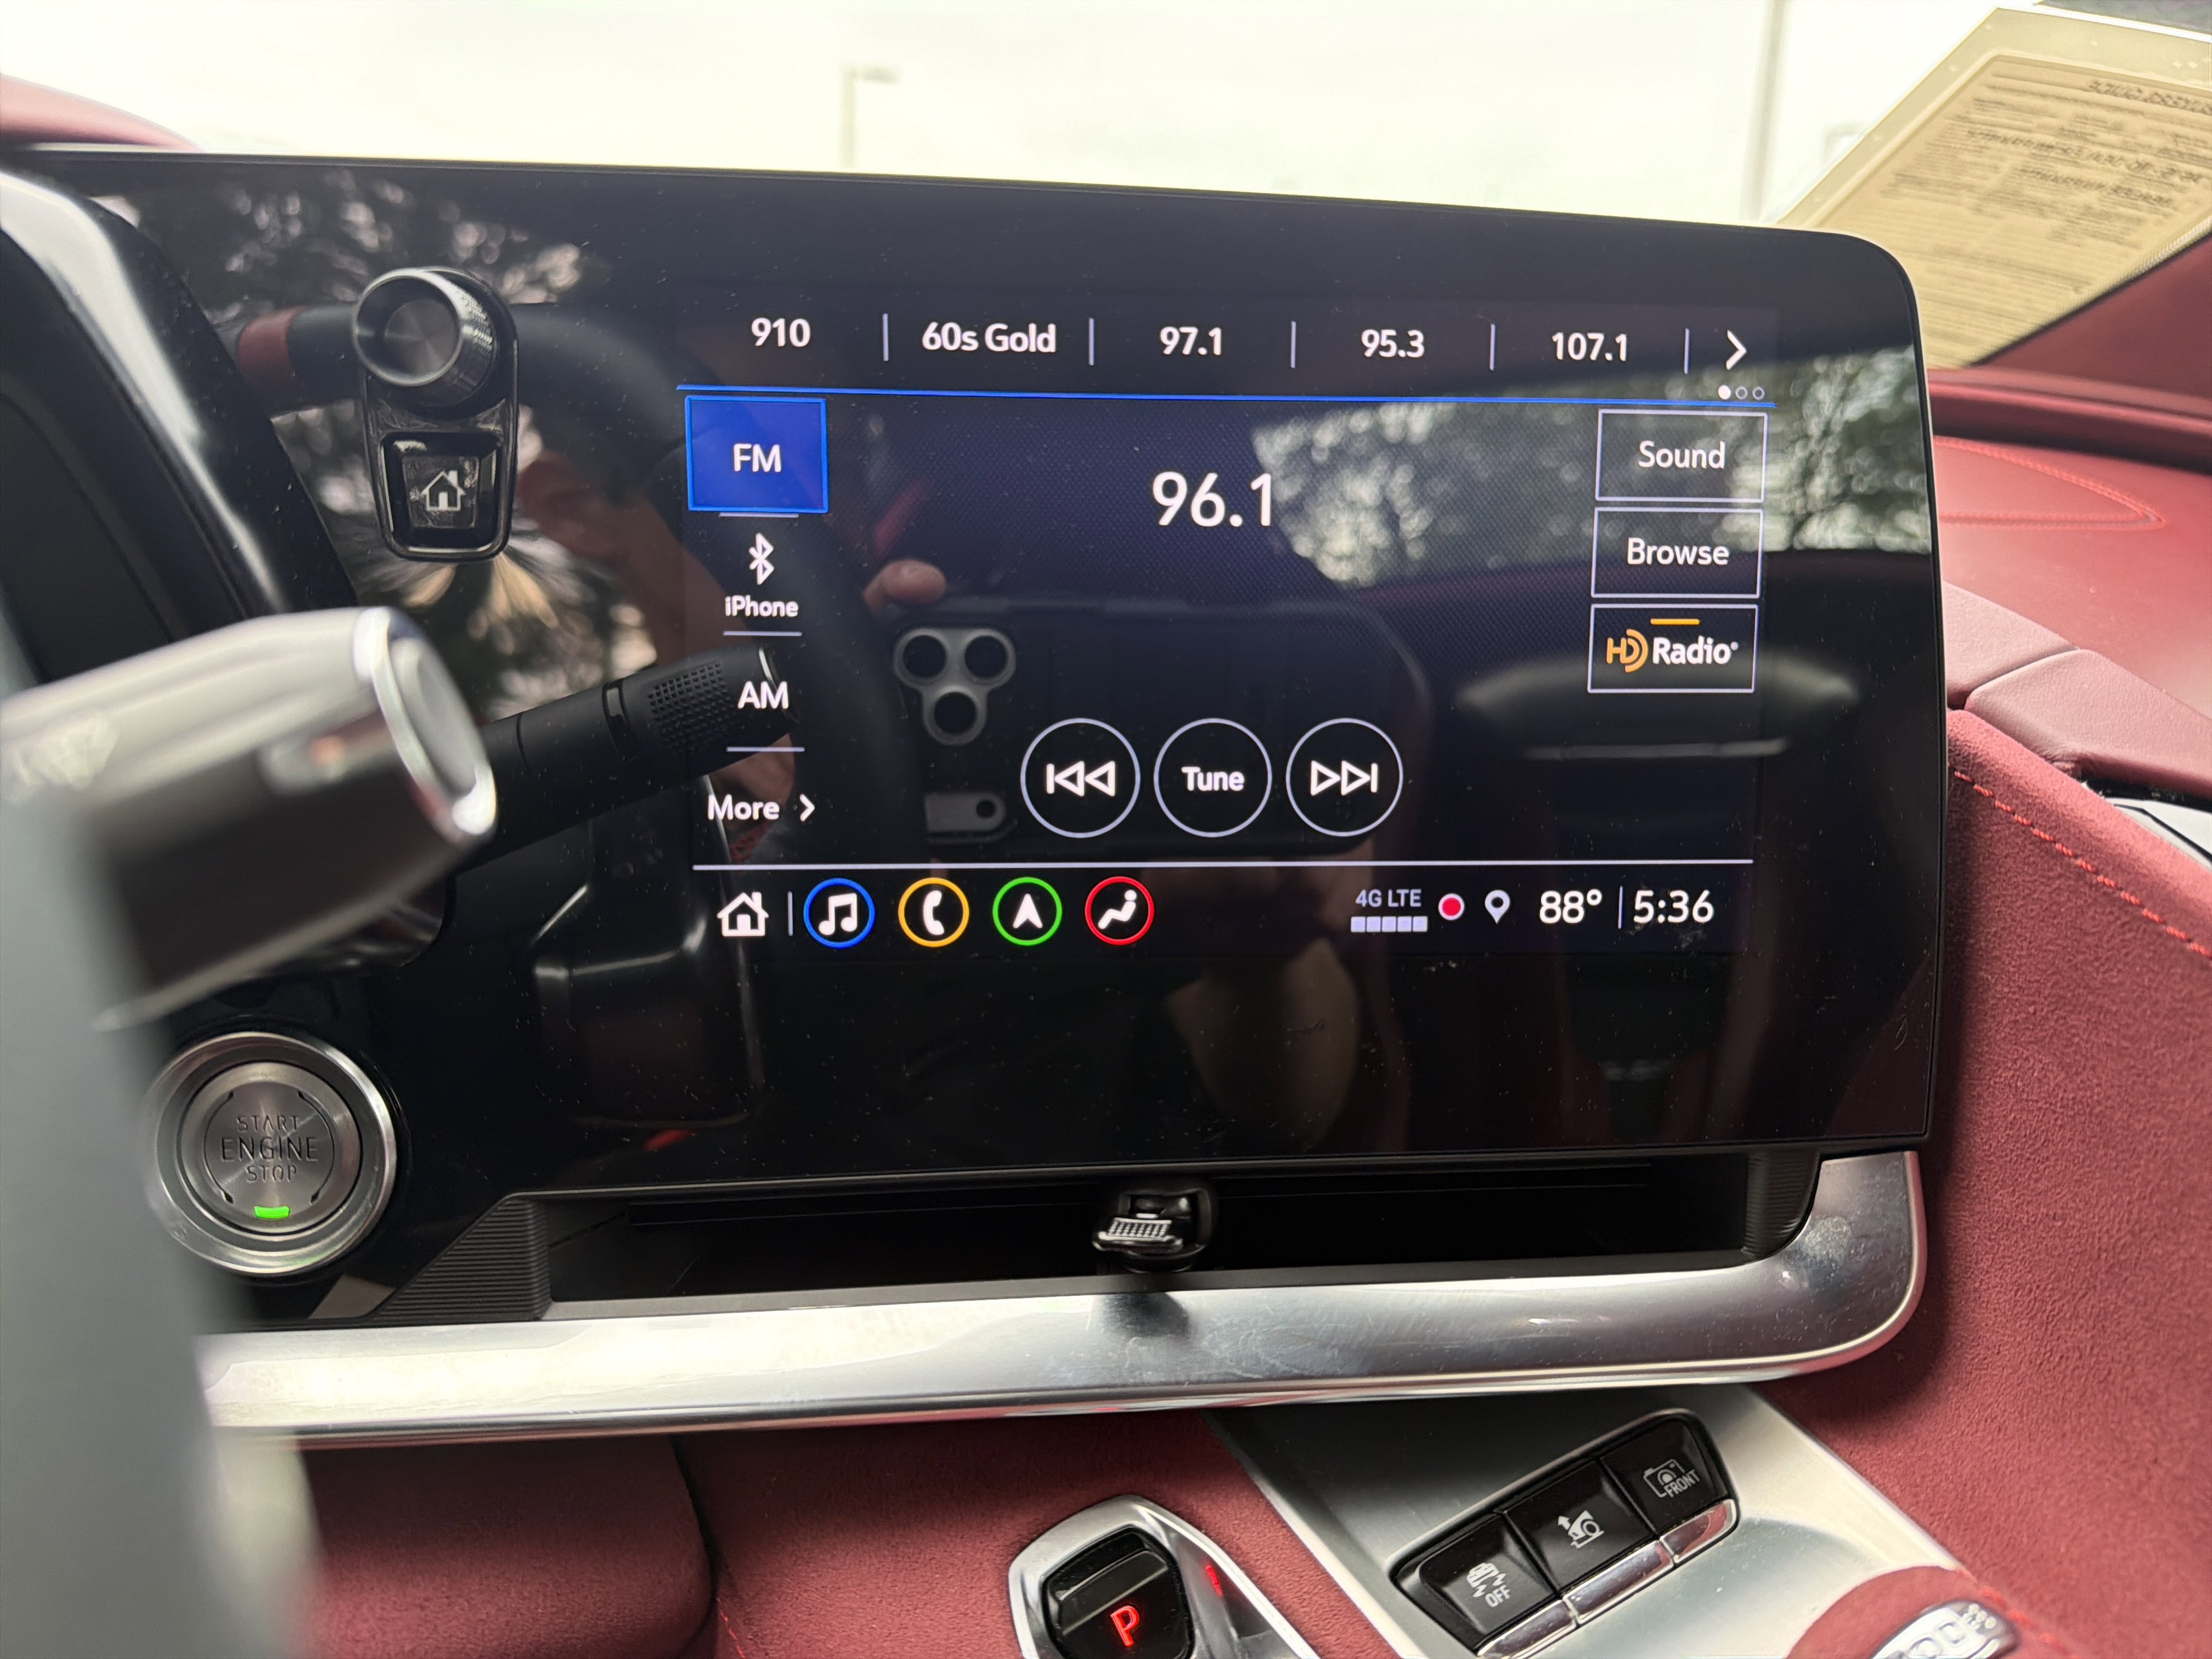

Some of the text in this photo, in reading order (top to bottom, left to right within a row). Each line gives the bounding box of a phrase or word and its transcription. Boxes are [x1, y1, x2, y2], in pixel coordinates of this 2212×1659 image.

[751, 318, 811, 347] 910
[922, 321, 1057, 353] 60s Gold
[1160, 326, 1222, 356] 97.1
[1361, 329, 1425, 358] 95.3
[1552, 332, 1628, 362] 107.1
[733, 443, 782, 473] FM
[1638, 440, 1726, 470] Sound
[1152, 472, 1273, 528] 96.1
[1627, 537, 1730, 566] Browse
[725, 595, 799, 617] iPhone
[1652, 635, 1732, 665] Radio
[737, 681, 789, 710] AM
[1181, 766, 1245, 792] Tune
[708, 794, 780, 821] More
[1355, 889, 1422, 908] 4G LTE
[1633, 889, 1714, 924] 5:36
[236, 1114, 301, 1132] START
[221, 1136, 319, 1163] ENGINE
[245, 1164, 298, 1183] STOP
[1663, 1469, 1700, 1498] FRONT
[1485, 1584, 1510, 1607] OFF
[1109, 1604, 1141, 1647] P
